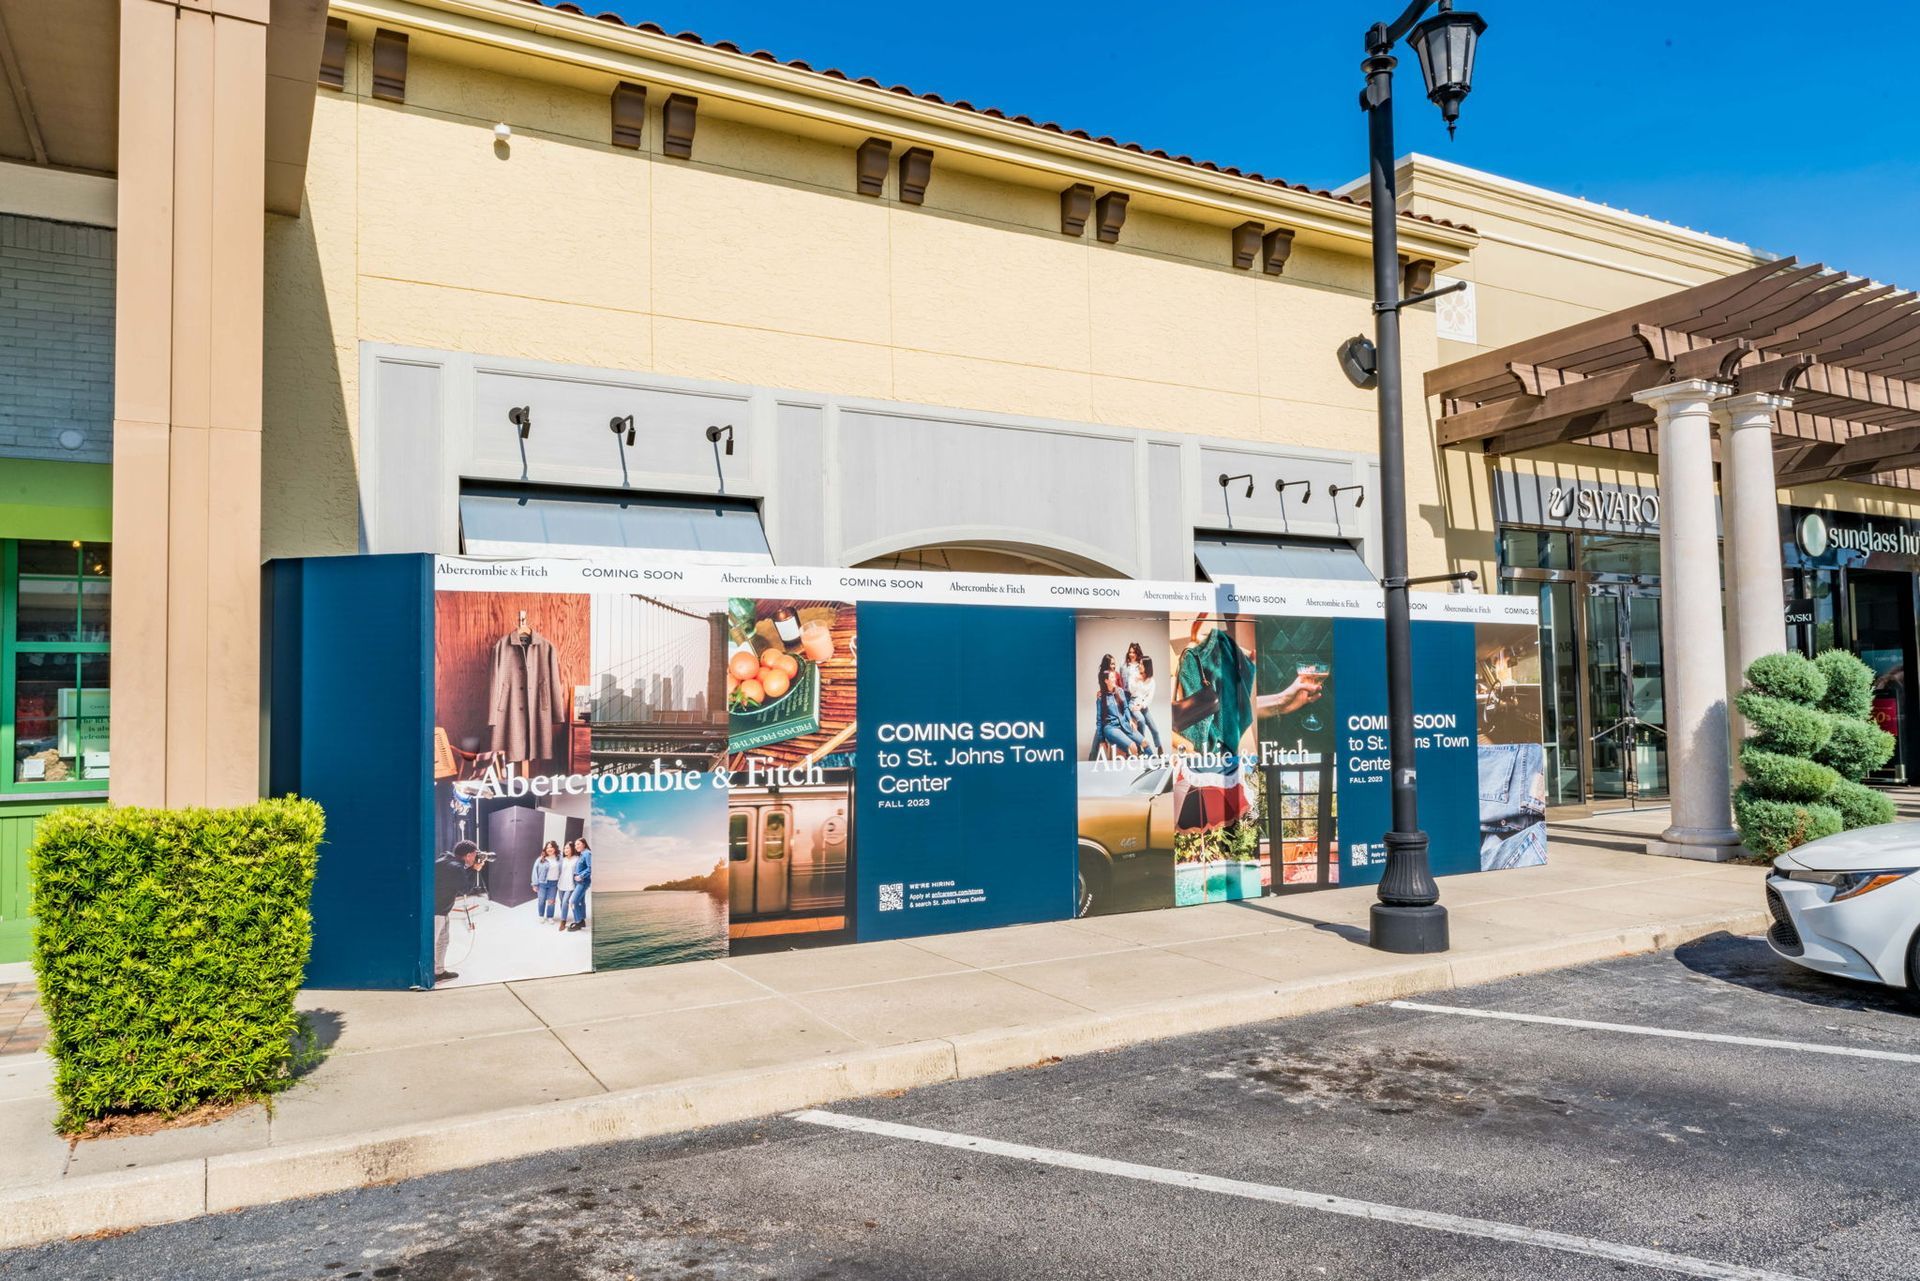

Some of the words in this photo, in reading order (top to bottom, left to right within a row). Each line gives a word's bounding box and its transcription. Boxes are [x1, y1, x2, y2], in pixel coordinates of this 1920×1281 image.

[1579, 488, 1660, 524] SWARO
[1829, 522, 1898, 559] sunglass
[437, 563, 508, 577] Abercrombie
[510, 568, 519, 576] &
[521, 565, 548, 577] Fitch
[582, 567, 639, 579] COMING
[644, 570, 684, 580] SOON
[721, 573, 780, 586] Abercrombie
[781, 577, 788, 586] &
[790, 575, 812, 587] Fitch
[839, 577, 887, 588] COMING
[890, 579, 924, 589] SOON
[950, 582, 998, 594] Abercrombie
[1006, 584, 1025, 594] Fitch
[1050, 586, 1090, 596] COMING
[1092, 587, 1120, 597] SOON
[1143, 590, 1184, 601] Abercrombie
[1190, 592, 1207, 602] Fitch
[1227, 594, 1261, 603] COMING
[1263, 595, 1287, 604] SOON
[1306, 597, 1340, 608] Abercrombie
[1346, 599, 1360, 609] Fitch
[1504, 607, 1530, 615] COMING
[1784, 613, 1812, 623] OVSKI
[1348, 715, 1388, 730] COMI
[1413, 714, 1456, 729] SOON
[751, 731, 777, 744] FROM
[877, 722, 974, 742] COMING
[979, 721, 1044, 740] SOON
[1349, 736, 1363, 751] to
[1367, 735, 1387, 750] St.
[1433, 733, 1470, 748] Town
[878, 750, 900, 767] to
[907, 748, 937, 767] St.
[945, 747, 1004, 766] Johns
[1010, 745, 1064, 763] Town
[1092, 742, 1233, 773] Abercrombie
[1239, 751, 1257, 767] &
[1260, 738, 1311, 766] Fitch
[1349, 756, 1391, 772] Cente
[472, 759, 701, 800] Abercrombie
[712, 764, 733, 789] &
[744, 754, 825, 789] Fitch
[878, 774, 952, 794] Center
[878, 800, 904, 808] FALL
[907, 798, 930, 807] 2023
[931, 880, 955, 888] HIRING
